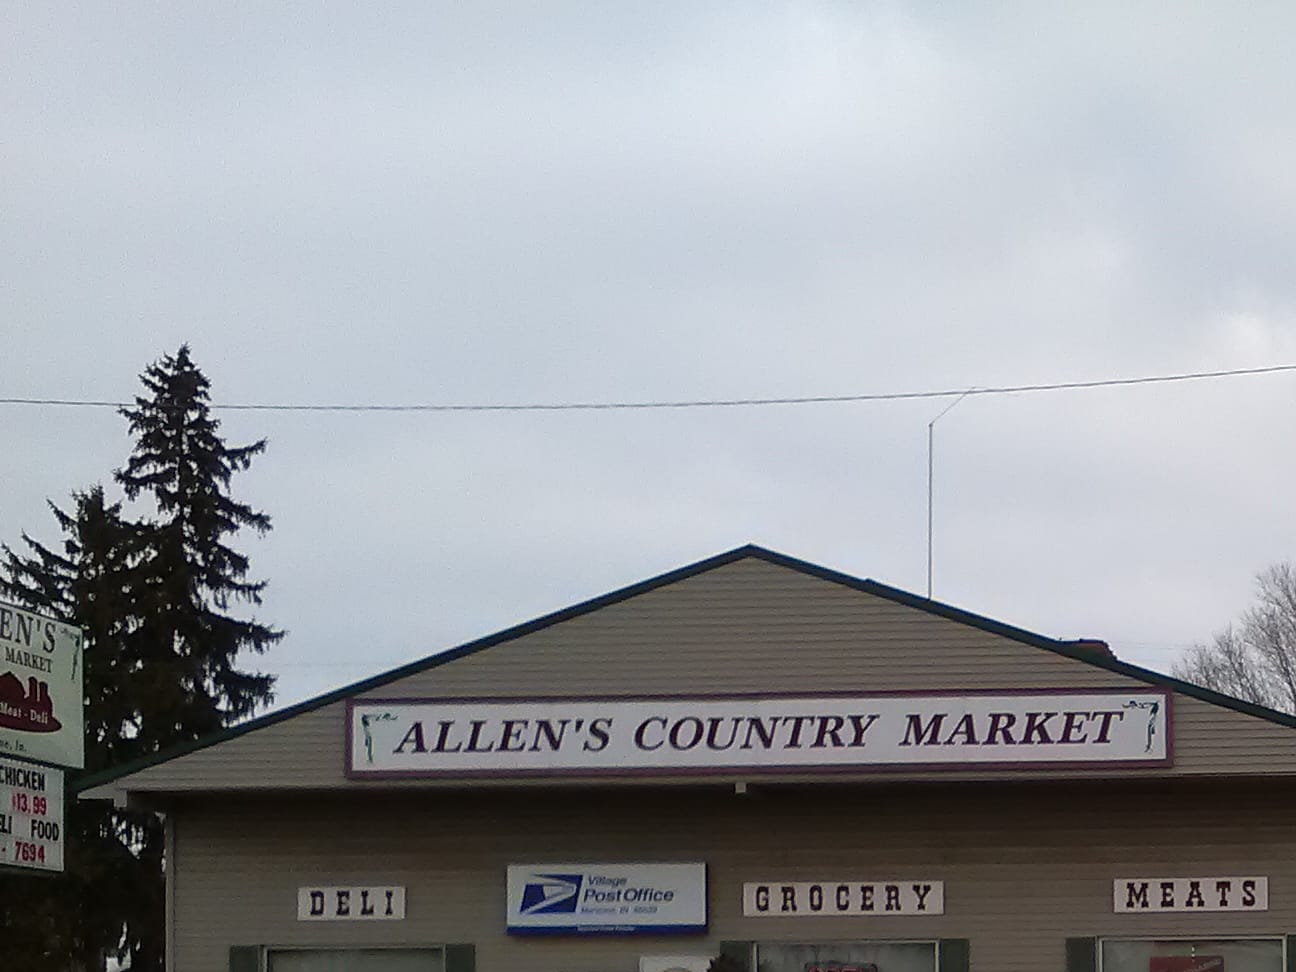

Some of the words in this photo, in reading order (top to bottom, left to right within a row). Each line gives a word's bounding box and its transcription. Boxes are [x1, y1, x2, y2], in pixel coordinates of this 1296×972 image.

[5, 646, 53, 673] MARKET
[30, 709, 48, 724] Deli
[393, 717, 613, 753] ALLEN'S
[635, 714, 879, 752] COUNTRY
[898, 711, 1125, 747] MARKET
[0, 765, 45, 791] CHICKEN
[31, 819, 59, 841] FOOD
[15, 841, 45, 863] 7694
[588, 875, 628, 888] Village
[310, 890, 393, 915] DELI
[584, 888, 621, 903] Post
[624, 887, 674, 902] Office
[755, 884, 932, 911] GROCERY
[1126, 880, 1257, 909] MEATS
